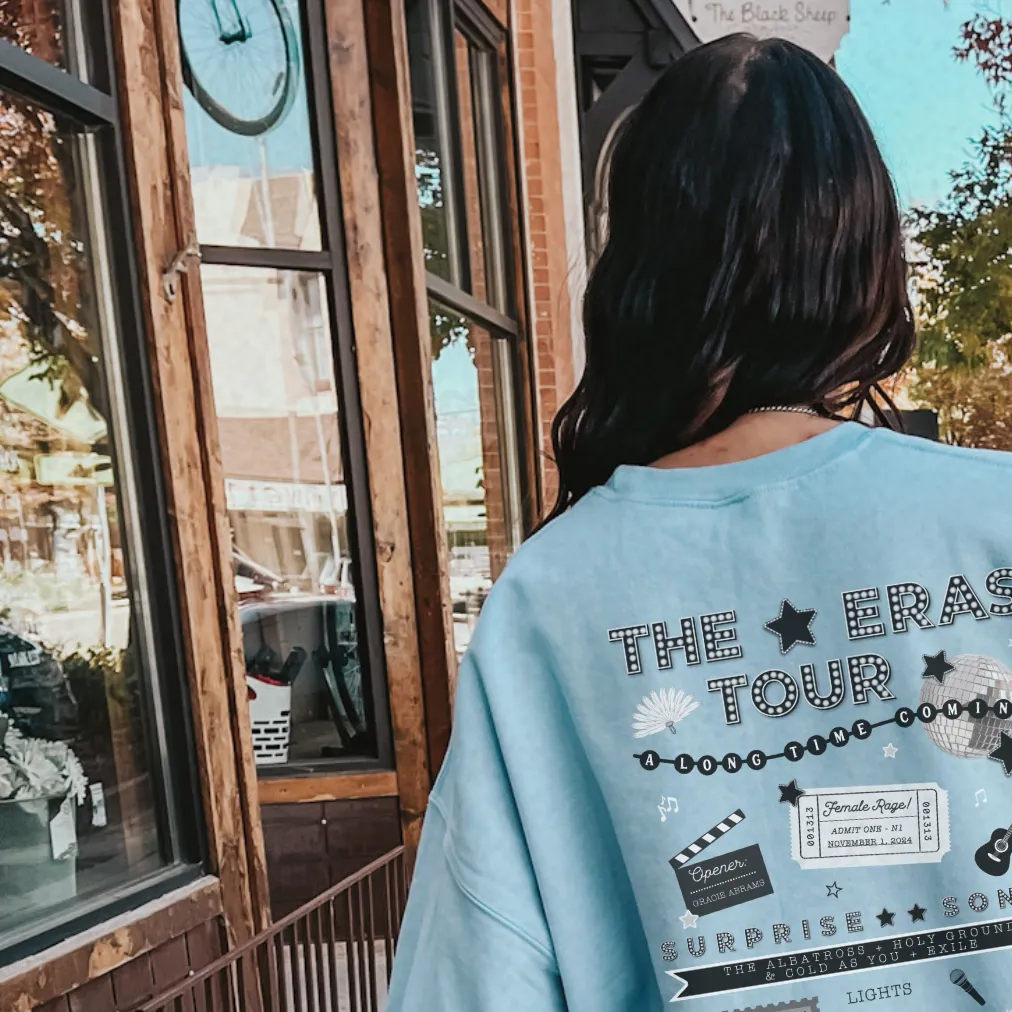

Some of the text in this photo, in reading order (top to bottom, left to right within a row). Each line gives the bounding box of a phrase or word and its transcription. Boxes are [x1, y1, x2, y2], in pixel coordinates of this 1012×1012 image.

[705, 1, 837, 23] The Black Sheep
[607, 610, 742, 675] THE
[706, 653, 897, 726] TOUR
[680, 754, 761, 772] LONG
[790, 722, 867, 758] TIME
[805, 806, 815, 847] 001313
[823, 797, 912, 817] Female Rage!
[922, 801, 932, 841] 001313
[827, 838, 877, 849] NOVEMBER
[890, 836, 913, 846] 2024
[831, 827, 861, 835] ADMIT
[863, 825, 882, 834] ONE
[891, 824, 903, 832] N1
[688, 859, 748, 884] Opener:
[692, 879, 766, 908] GRACIE ABRAMS
[660, 911, 864, 962] SURPRISE
[723, 962, 757, 977] THE
[765, 944, 866, 970] ALBATROSS
[892, 934, 936, 951] HOLY
[765, 972, 776, 982] &
[785, 963, 829, 979] COLD
[838, 958, 859, 970] AS
[867, 951, 900, 966] YOU
[927, 939, 979, 956] EXILE
[846, 982, 912, 1005] LIGHTS
